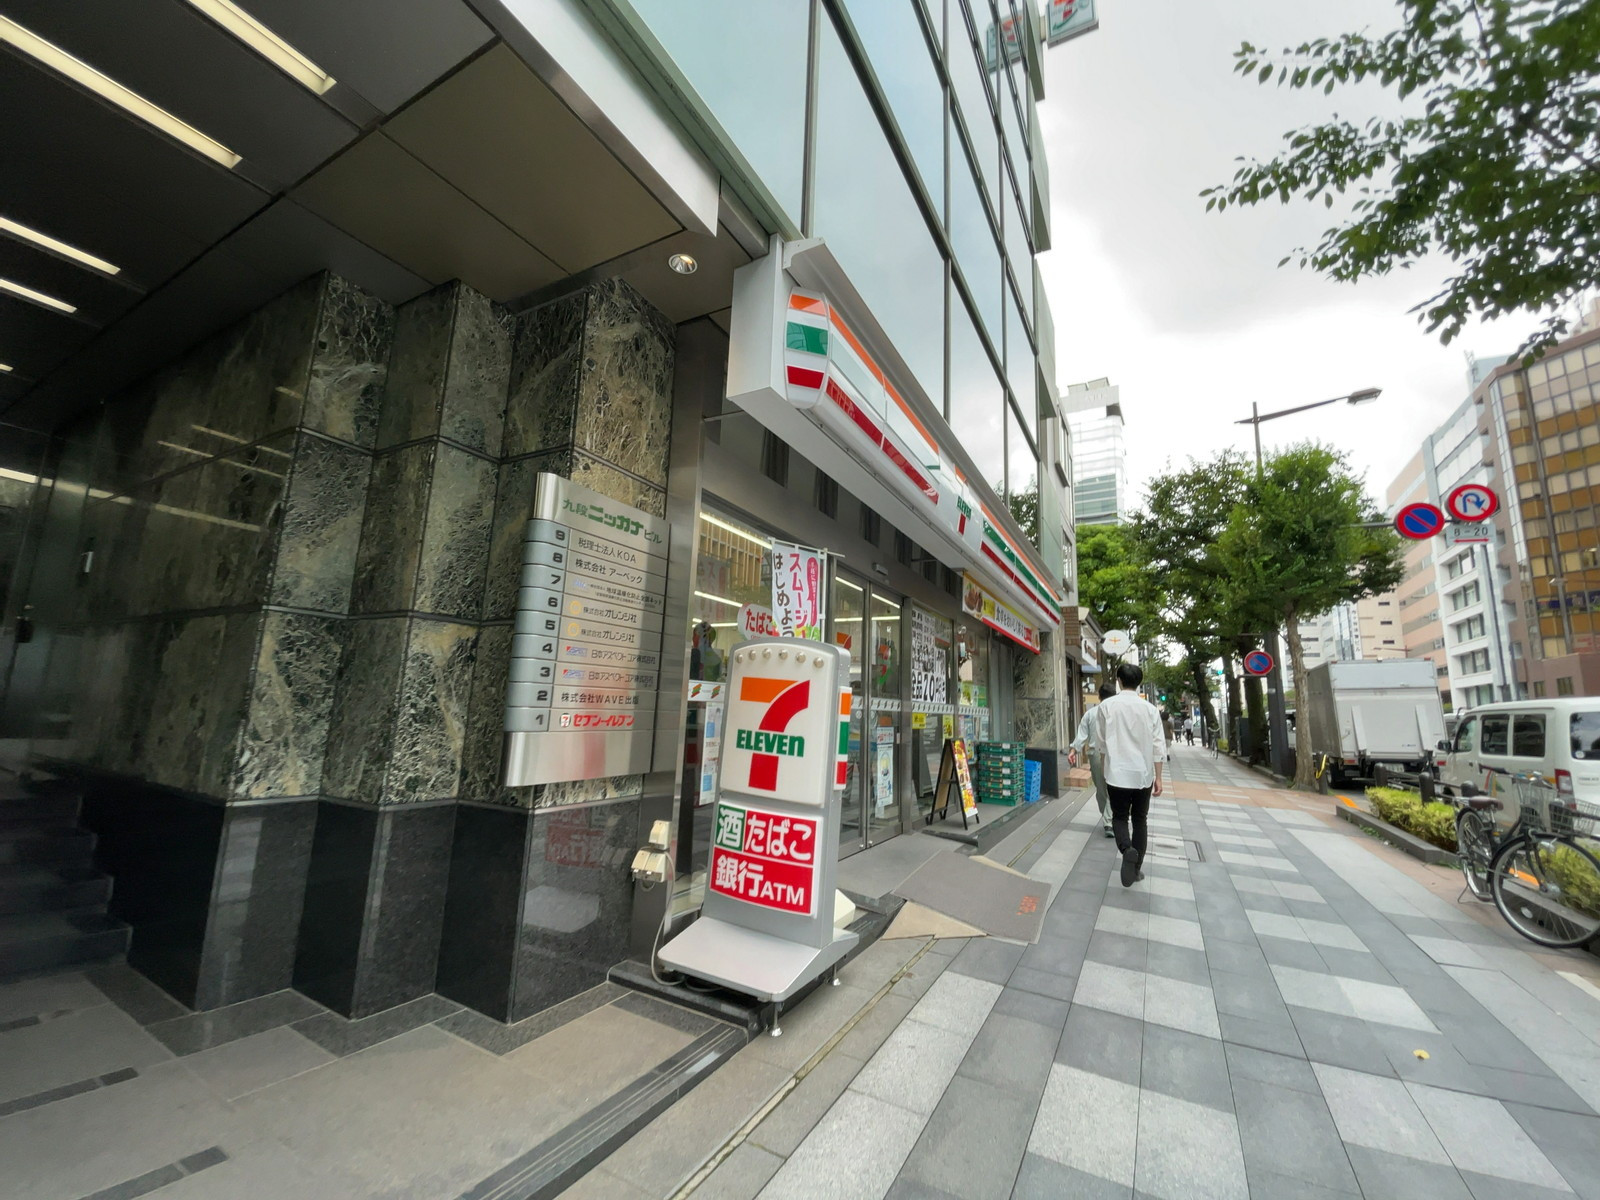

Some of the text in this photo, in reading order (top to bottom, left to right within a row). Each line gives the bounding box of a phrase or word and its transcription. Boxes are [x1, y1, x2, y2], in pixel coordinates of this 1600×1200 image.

[555, 529, 566, 542] 9
[552, 552, 563, 564] 8
[575, 558, 643, 584] 株式会社 アーベック
[550, 574, 561, 585] 7
[547, 597, 558, 608] 6
[544, 619, 556, 631] 5
[541, 643, 553, 655] 4
[539, 667, 551, 678] 3
[536, 690, 548, 701] 2
[535, 714, 544, 725] 1
[716, 807, 812, 861] 酒 たばこ
[714, 855, 806, 907] 銀行ATM
